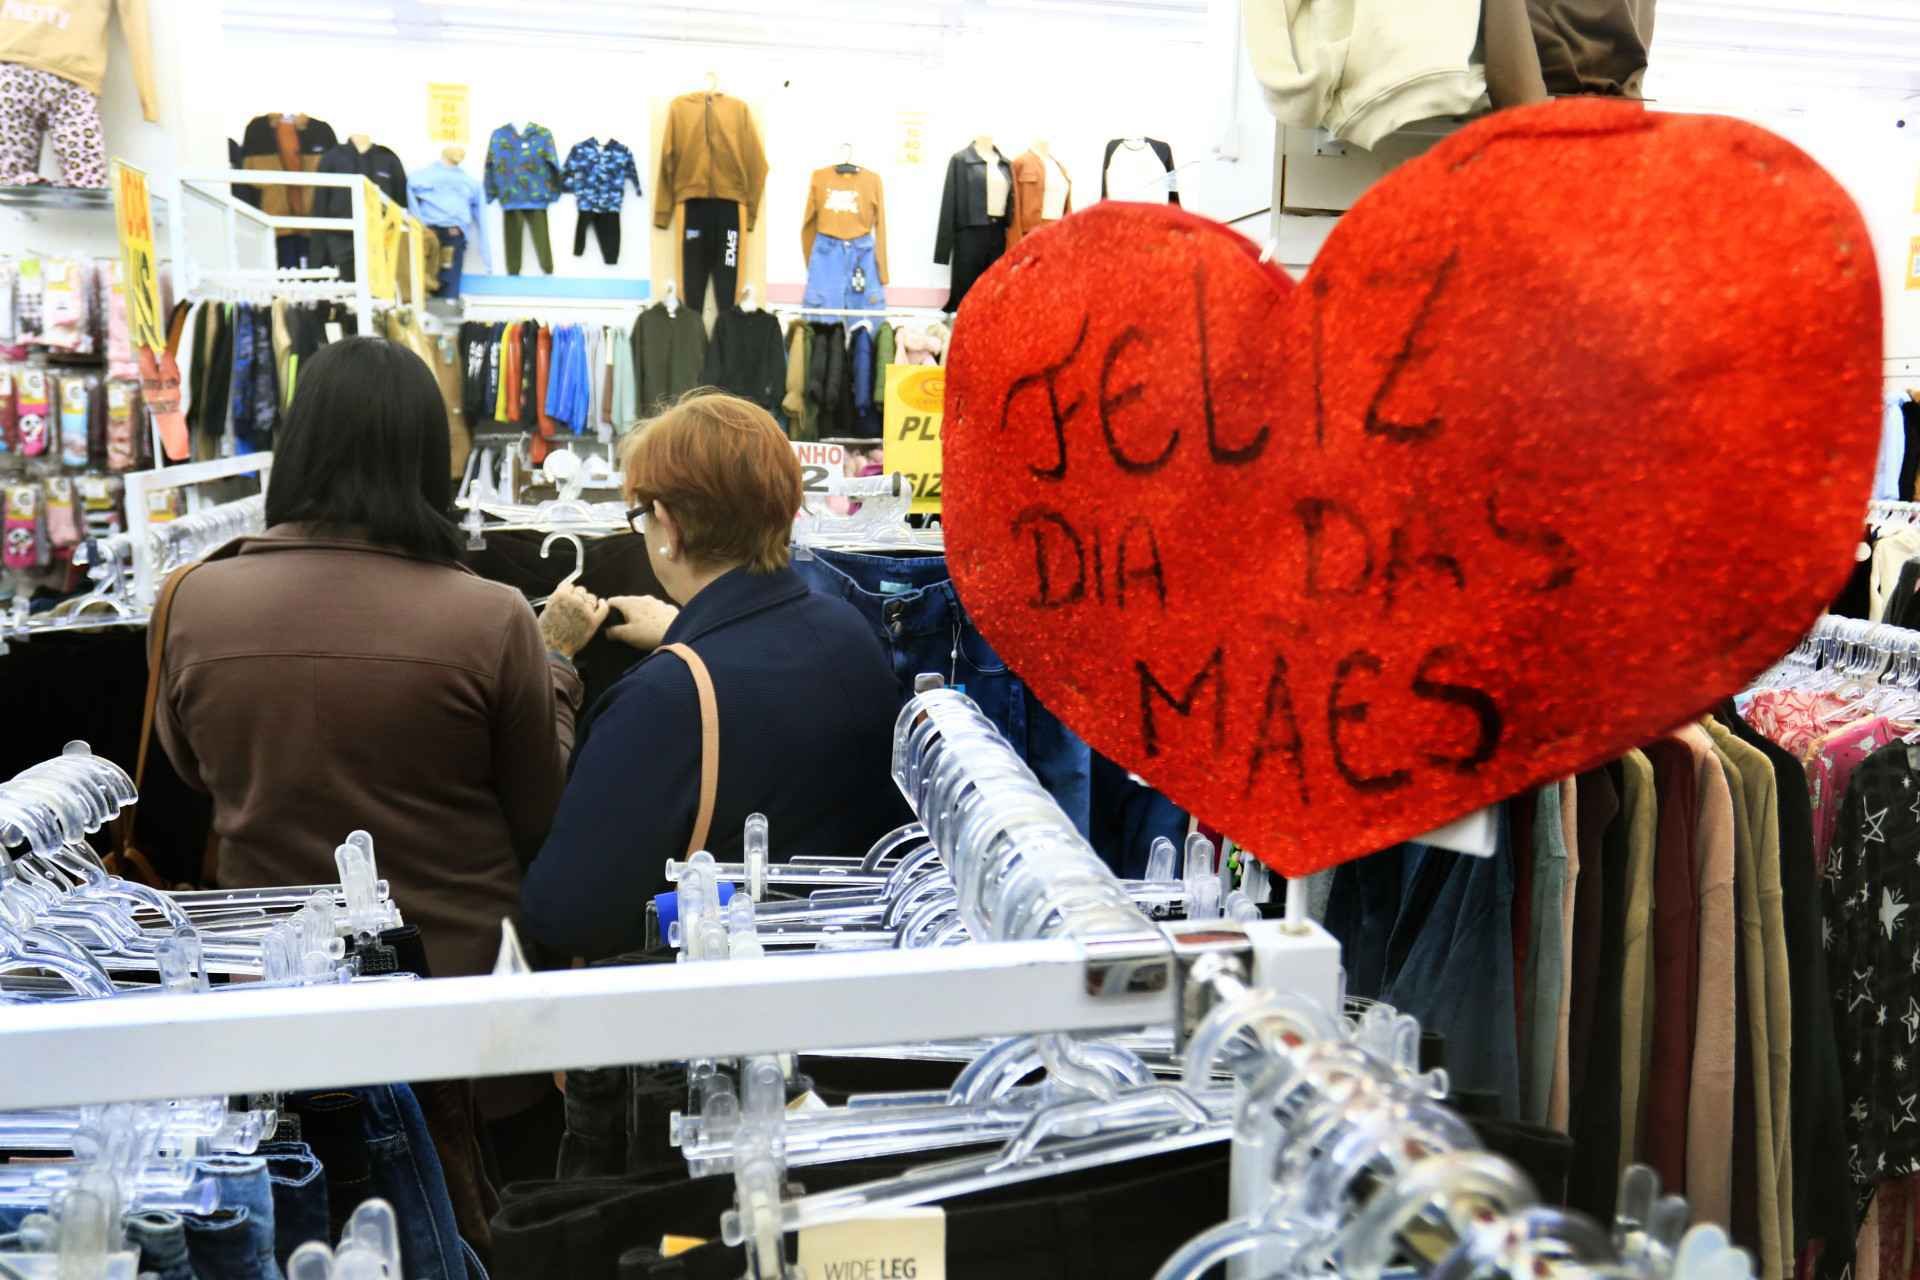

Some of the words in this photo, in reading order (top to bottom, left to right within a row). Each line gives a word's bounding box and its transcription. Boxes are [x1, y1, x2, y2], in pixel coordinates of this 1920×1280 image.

[999, 244, 1460, 481] FELIZ
[898, 415, 944, 441] PL
[798, 445, 842, 465] NHO
[1009, 506, 1168, 613] DIA
[1294, 489, 1578, 612] DAS
[824, 1258, 876, 1280] WIDE
[880, 1257, 917, 1280] LEG
